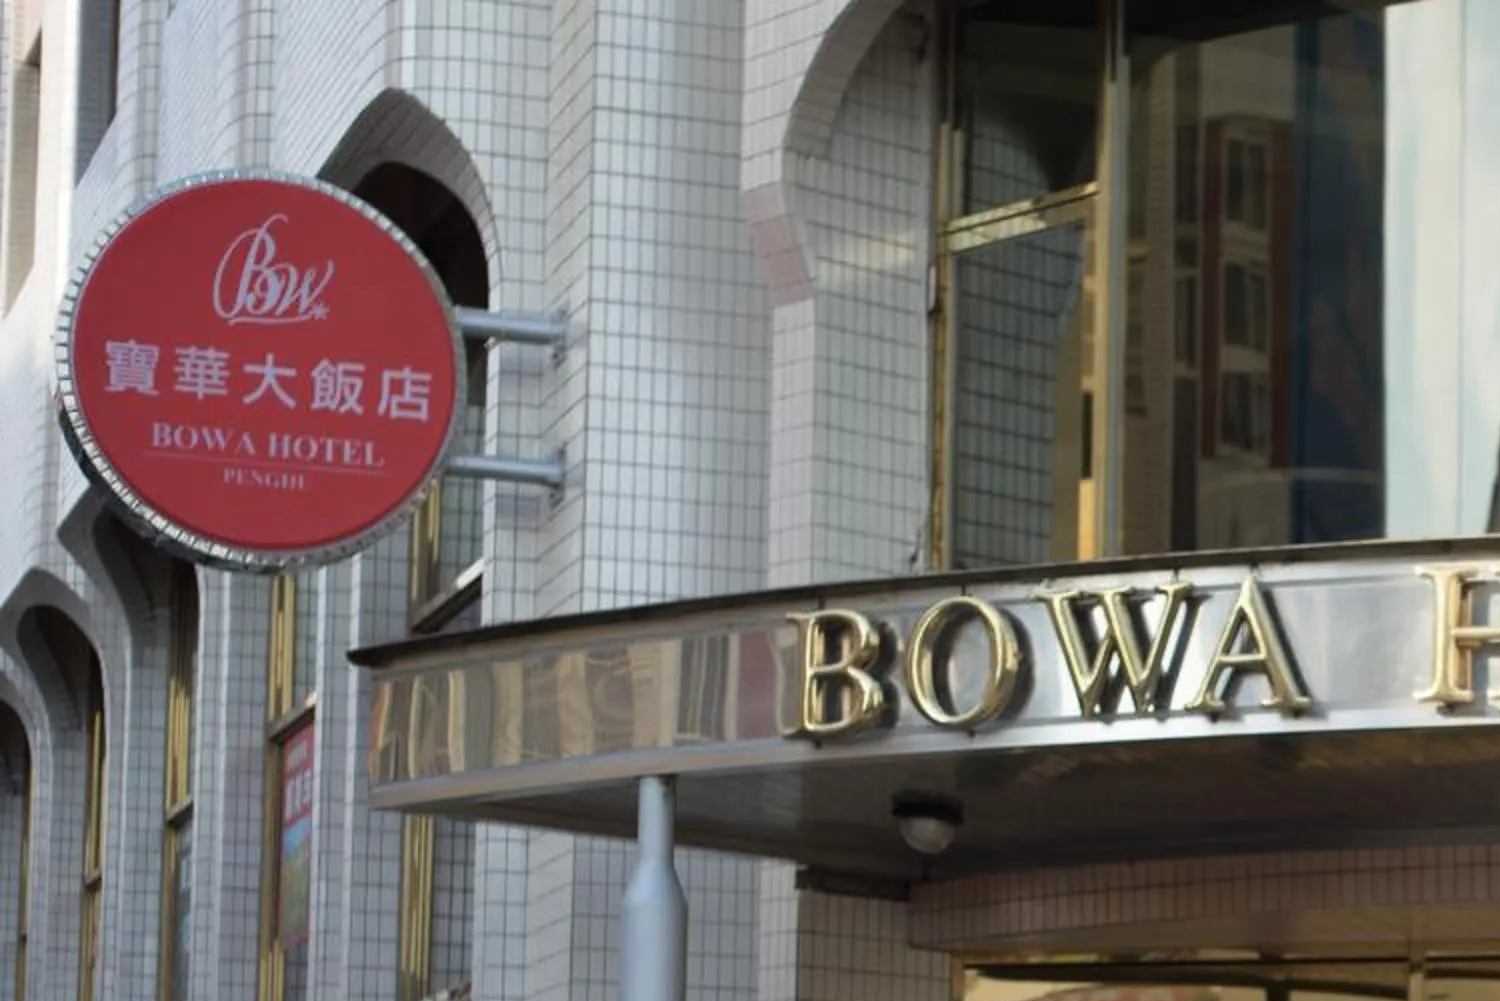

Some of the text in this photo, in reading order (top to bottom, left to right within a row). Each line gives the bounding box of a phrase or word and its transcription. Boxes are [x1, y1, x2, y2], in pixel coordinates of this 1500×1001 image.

[104, 339, 434, 422] 寶華大飯店
[151, 421, 385, 468] BOWA HOTEL
[222, 467, 308, 491] PENGHU
[784, 573, 1314, 740] BOWA
